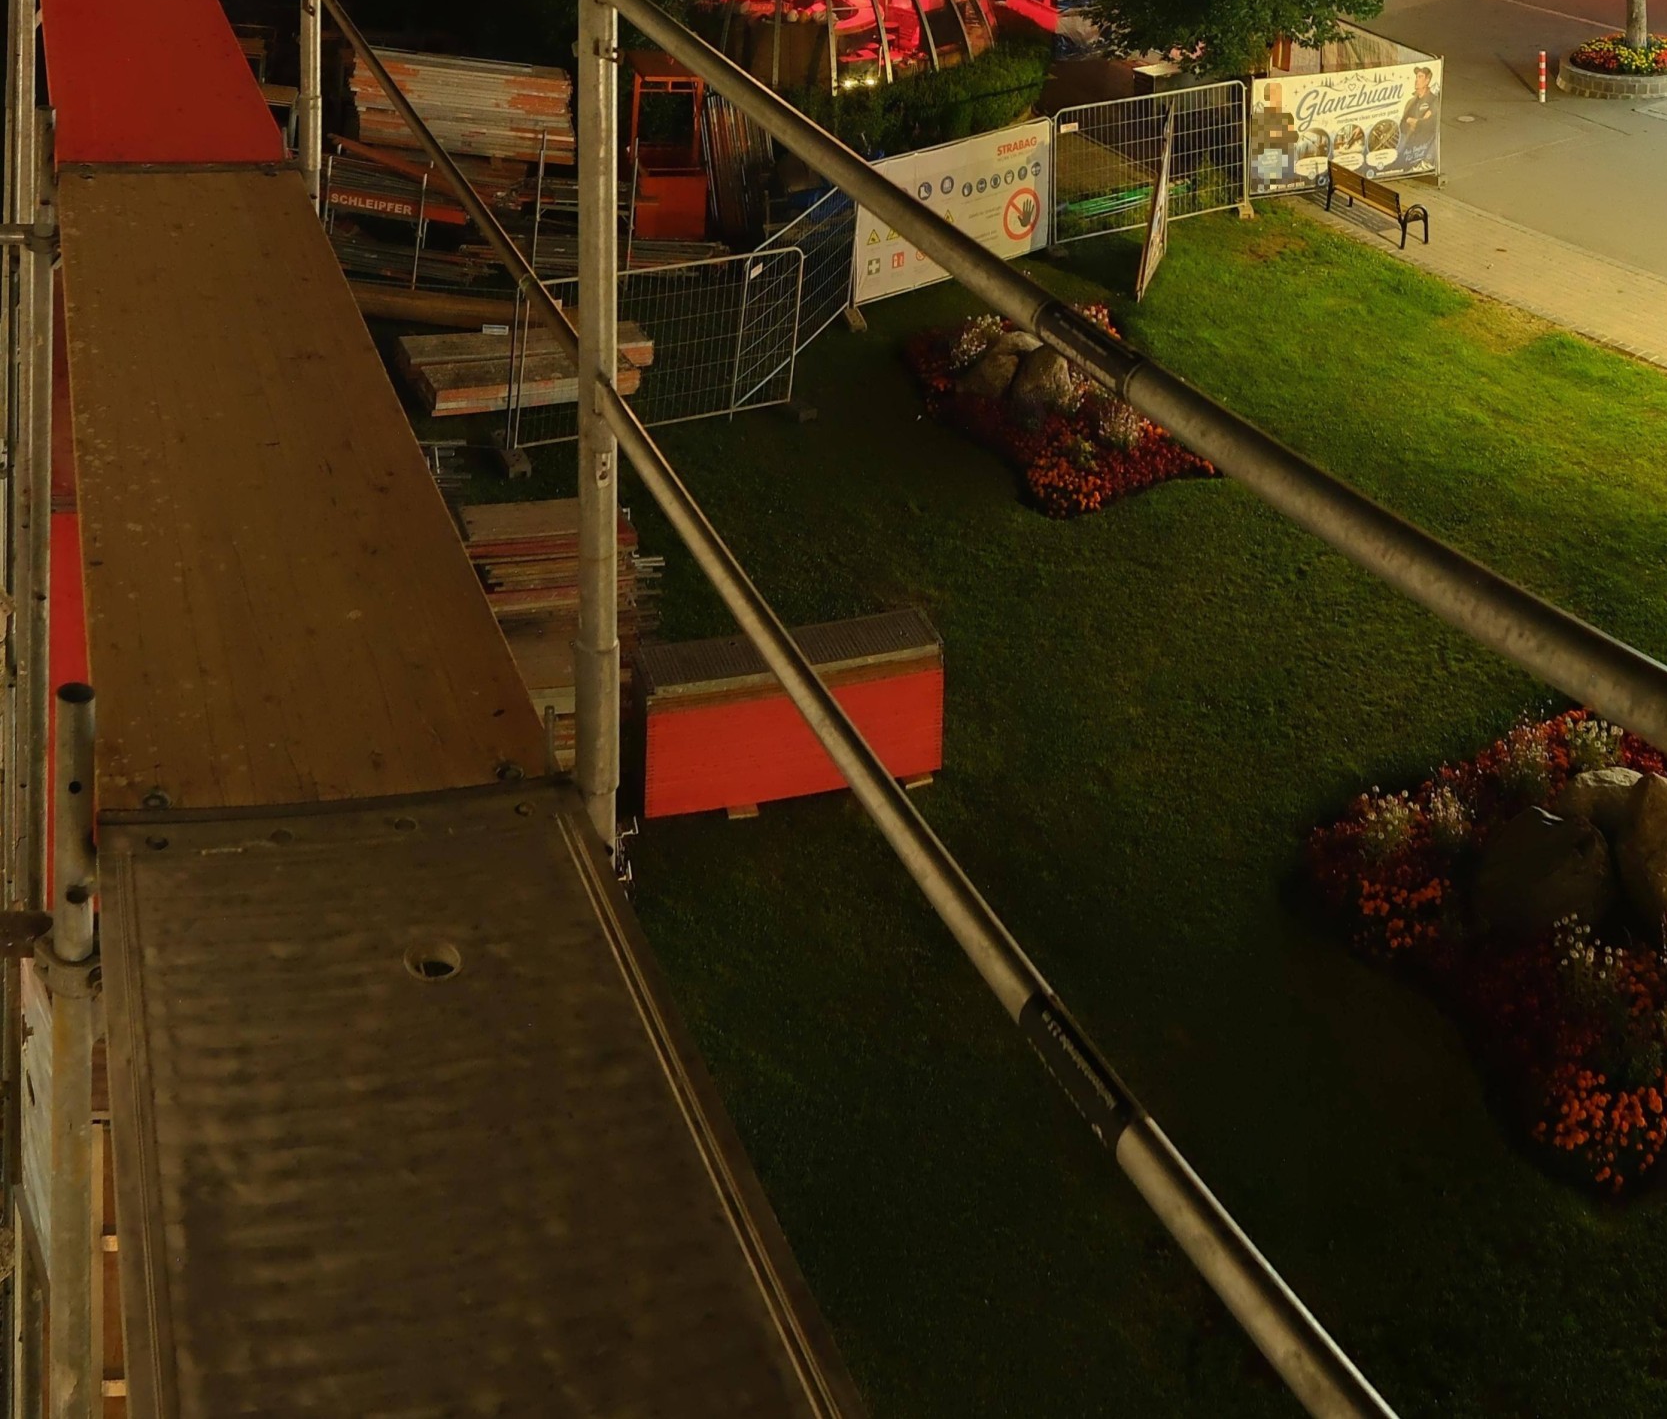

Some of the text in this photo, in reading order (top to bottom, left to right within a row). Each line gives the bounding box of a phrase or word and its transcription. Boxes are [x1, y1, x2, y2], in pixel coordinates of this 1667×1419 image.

[1295, 83, 1404, 131] Glanzbuam
[997, 136, 1037, 156] STRABAG
[331, 192, 412, 215] SCHLEIPFER
